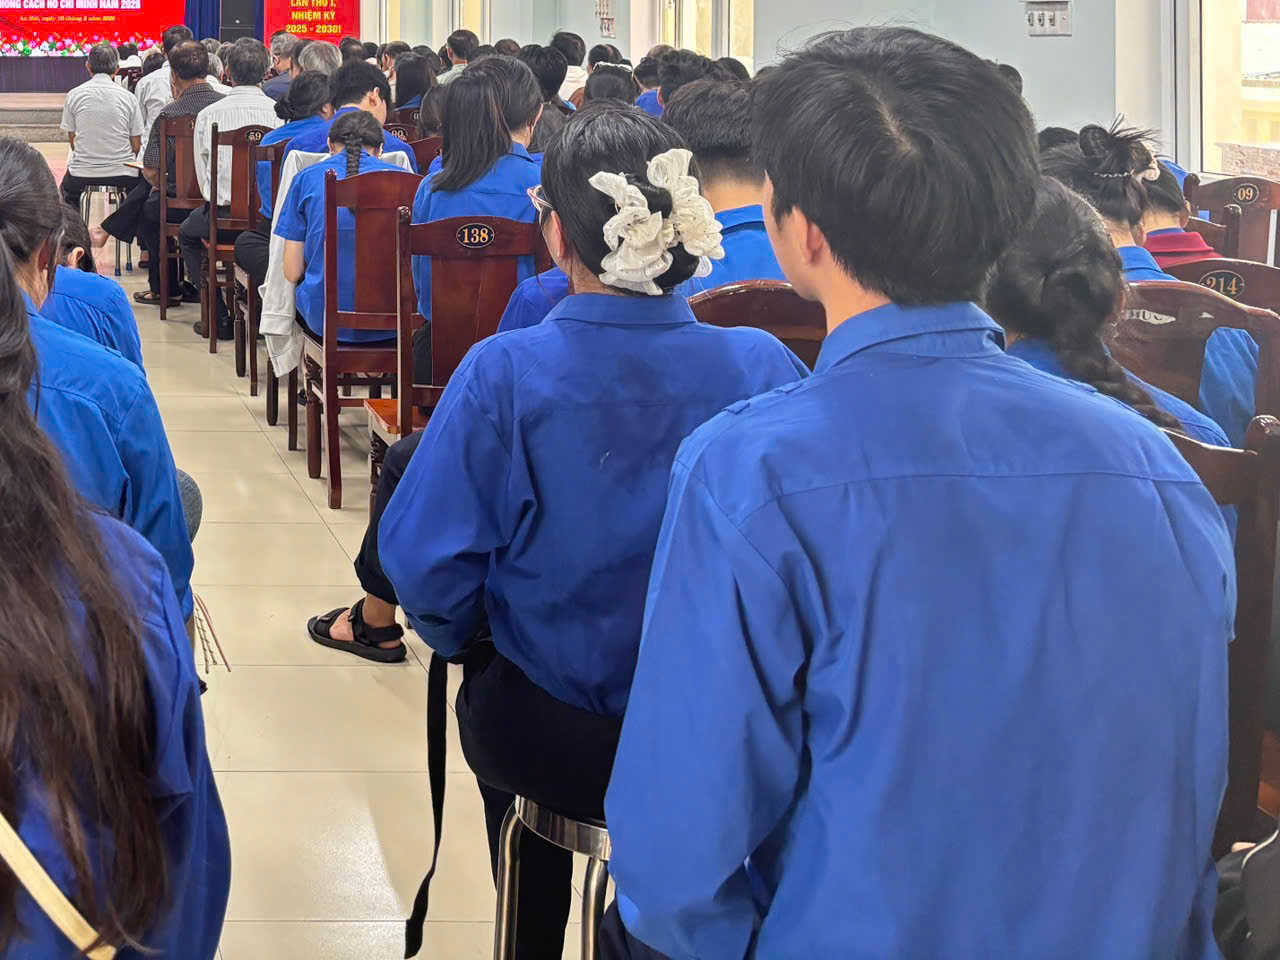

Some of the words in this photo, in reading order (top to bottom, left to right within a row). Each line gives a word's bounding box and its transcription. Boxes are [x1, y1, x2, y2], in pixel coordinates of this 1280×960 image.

[76, 0, 99, 8] MINH
[286, 24, 307, 33] 2025
[1237, 188, 1253, 201] 09
[462, 228, 489, 244] 138
[1206, 276, 1238, 295] 214
